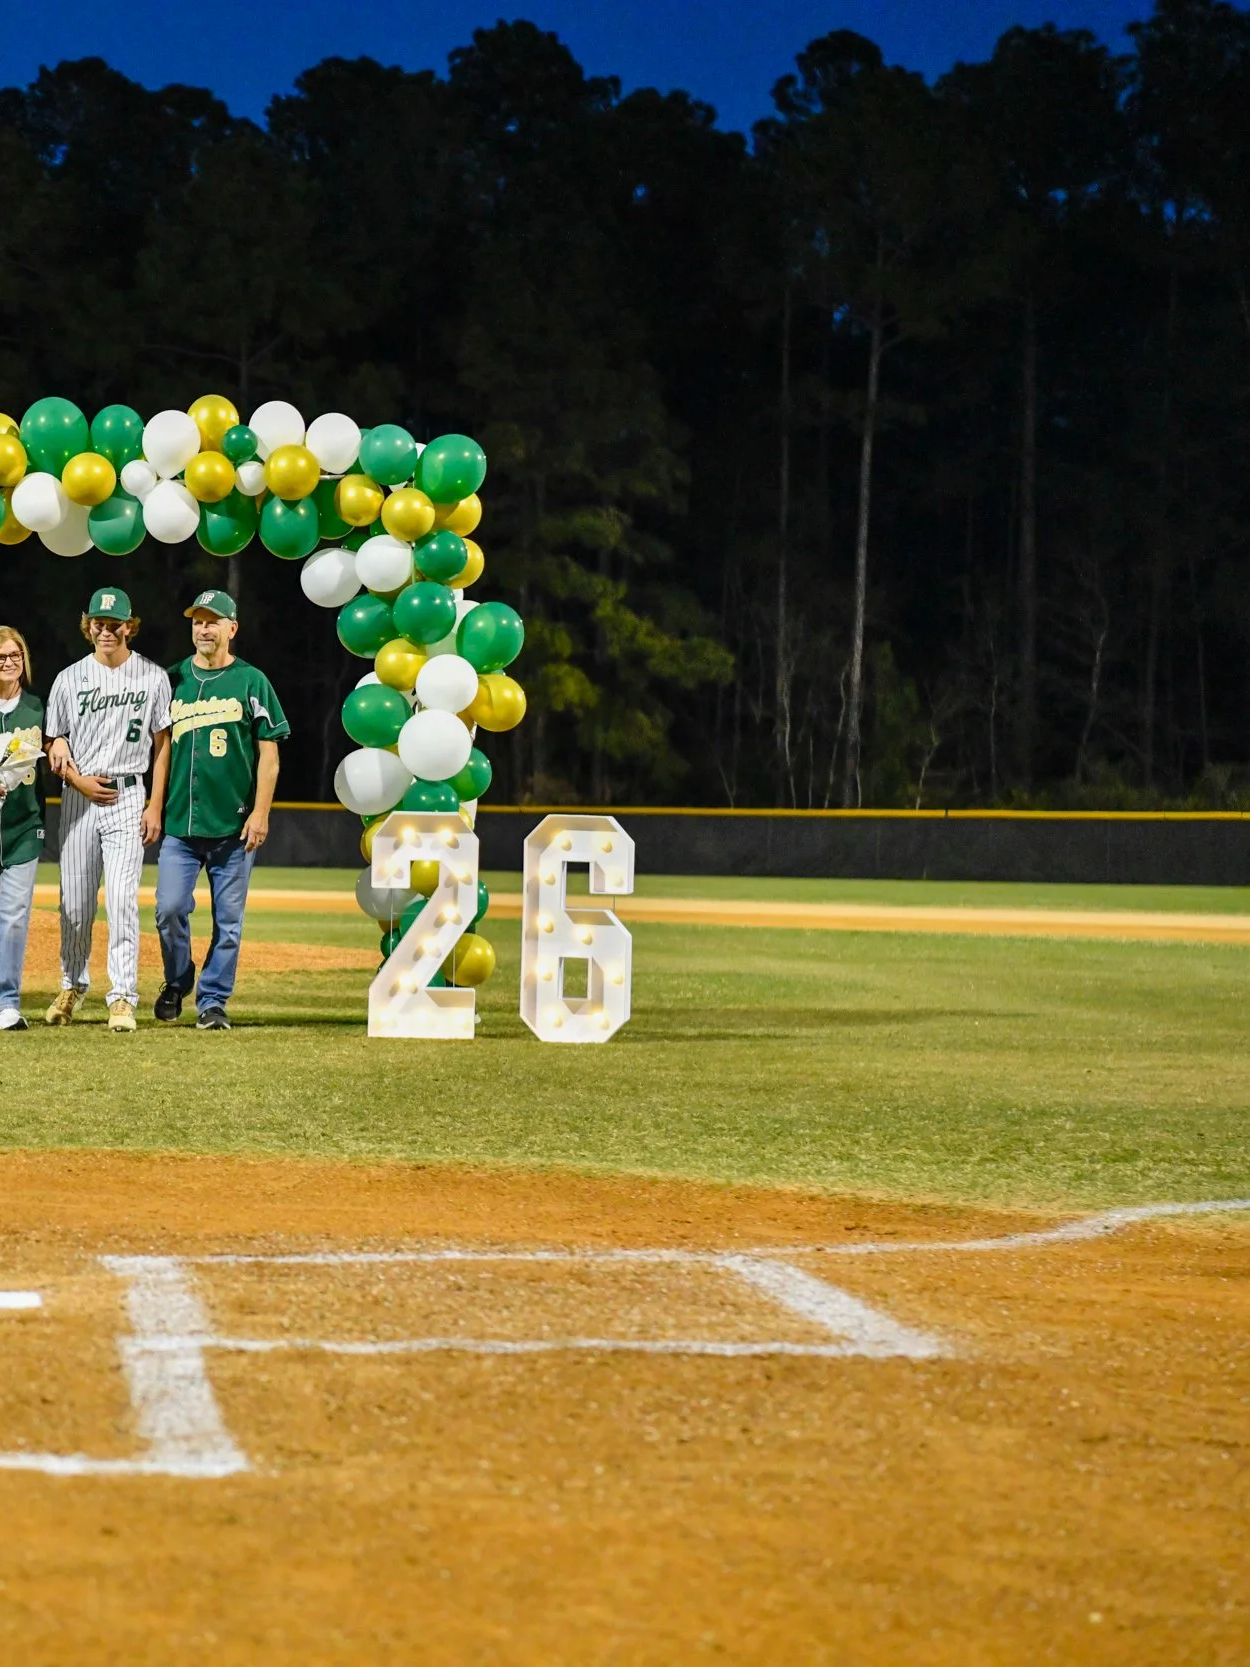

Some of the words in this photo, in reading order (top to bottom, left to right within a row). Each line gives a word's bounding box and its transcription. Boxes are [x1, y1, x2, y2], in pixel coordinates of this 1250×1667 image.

[77, 687, 148, 716] Fleming
[126, 719, 142, 743] 6
[209, 729, 227, 757] 6
